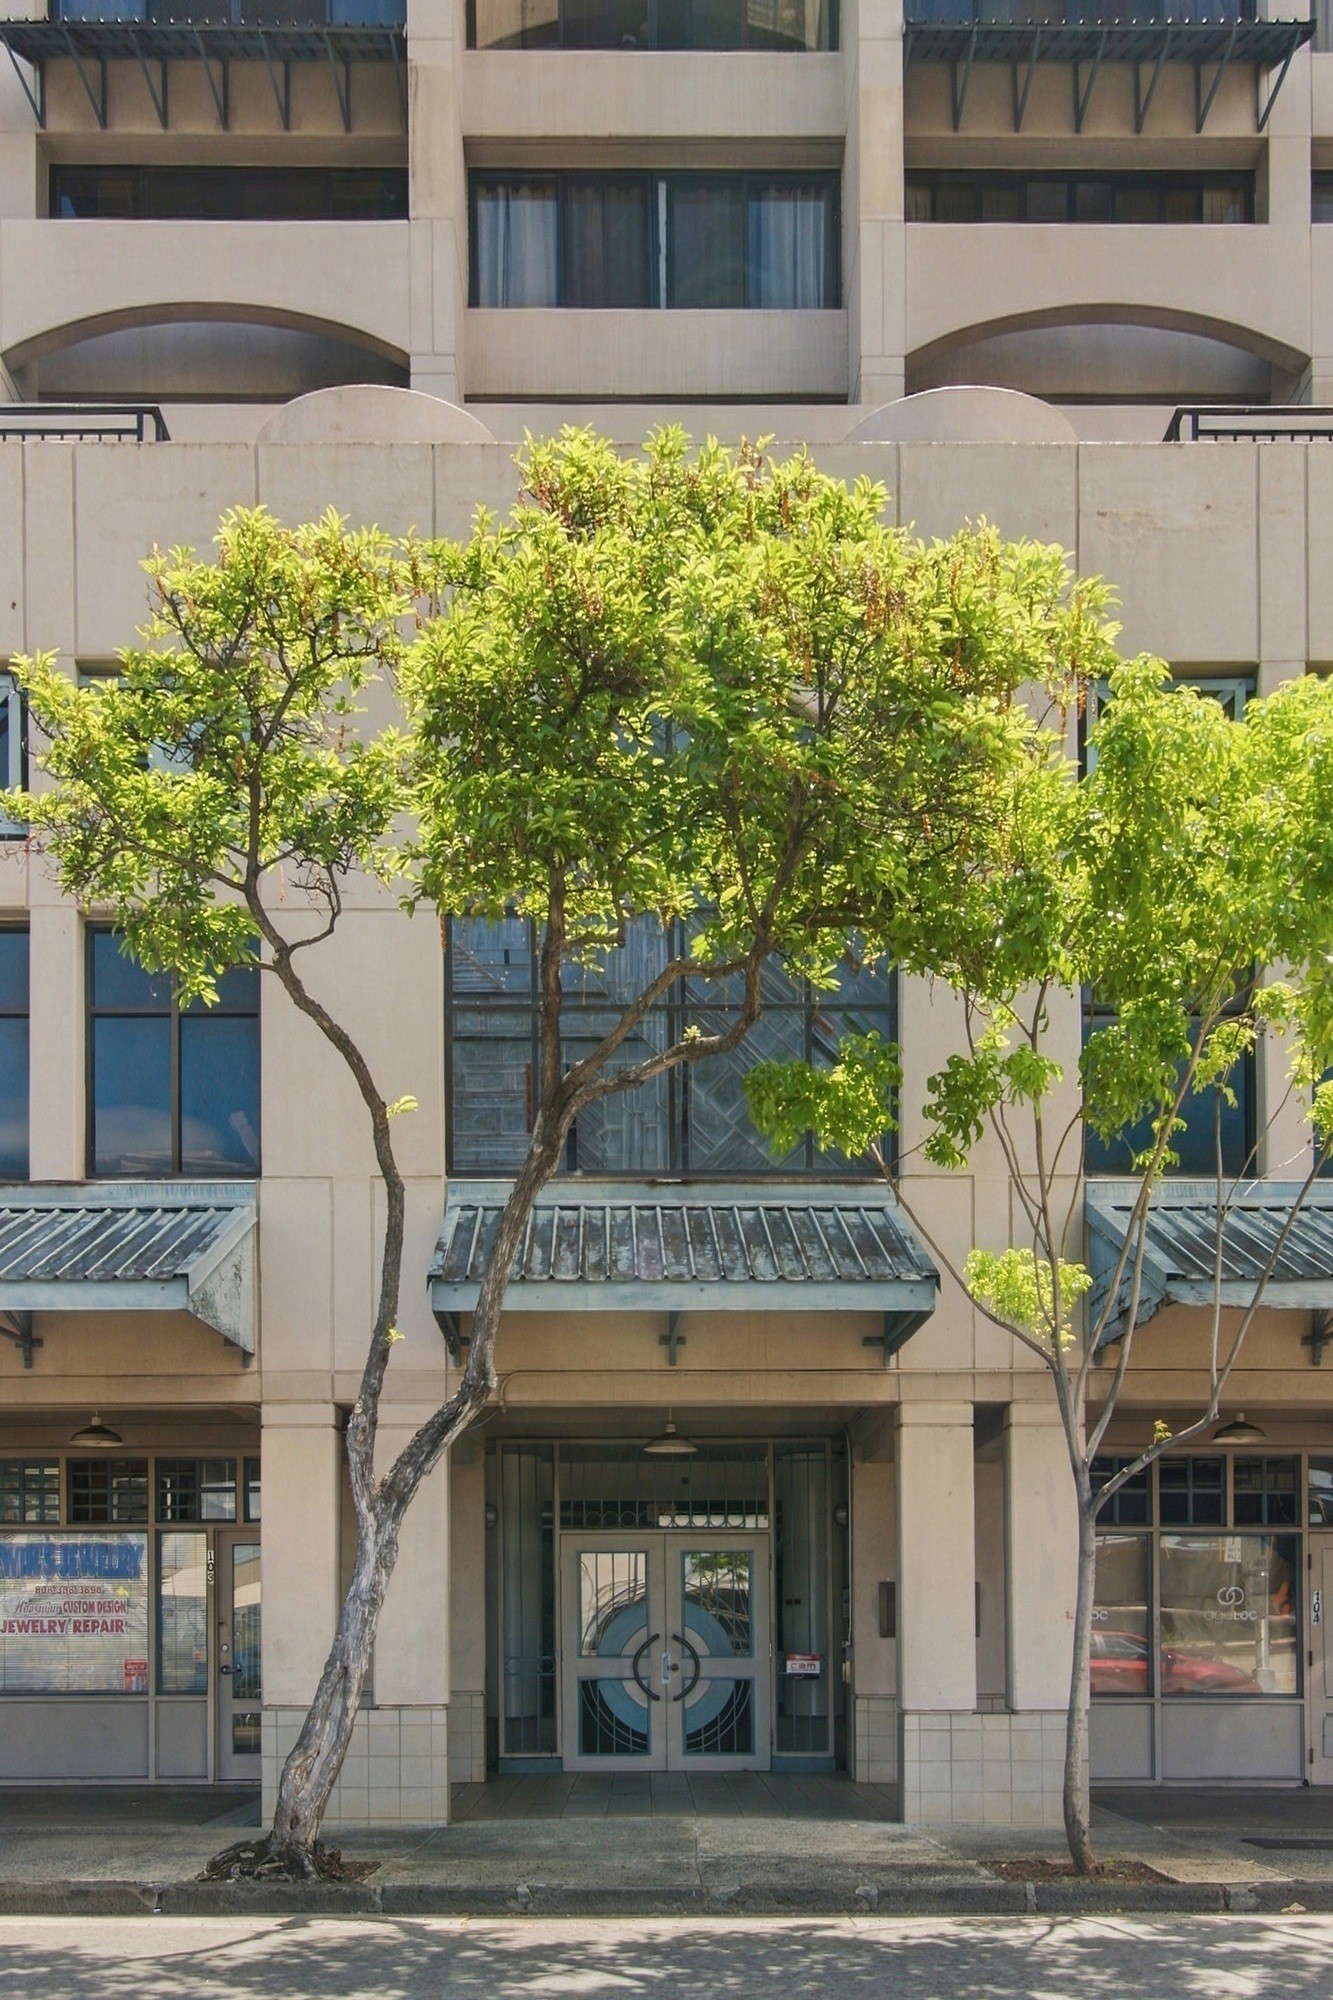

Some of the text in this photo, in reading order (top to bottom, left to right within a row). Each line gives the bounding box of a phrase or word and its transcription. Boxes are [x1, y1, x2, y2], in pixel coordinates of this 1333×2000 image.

[58, 1543, 144, 1579] JEWELRY
[62, 1600, 97, 1614] CUSTOM
[97, 1600, 127, 1614] DESIGN
[1313, 1590, 1321, 1624] 104
[0, 1618, 125, 1634] JEWELRY REPAIR
